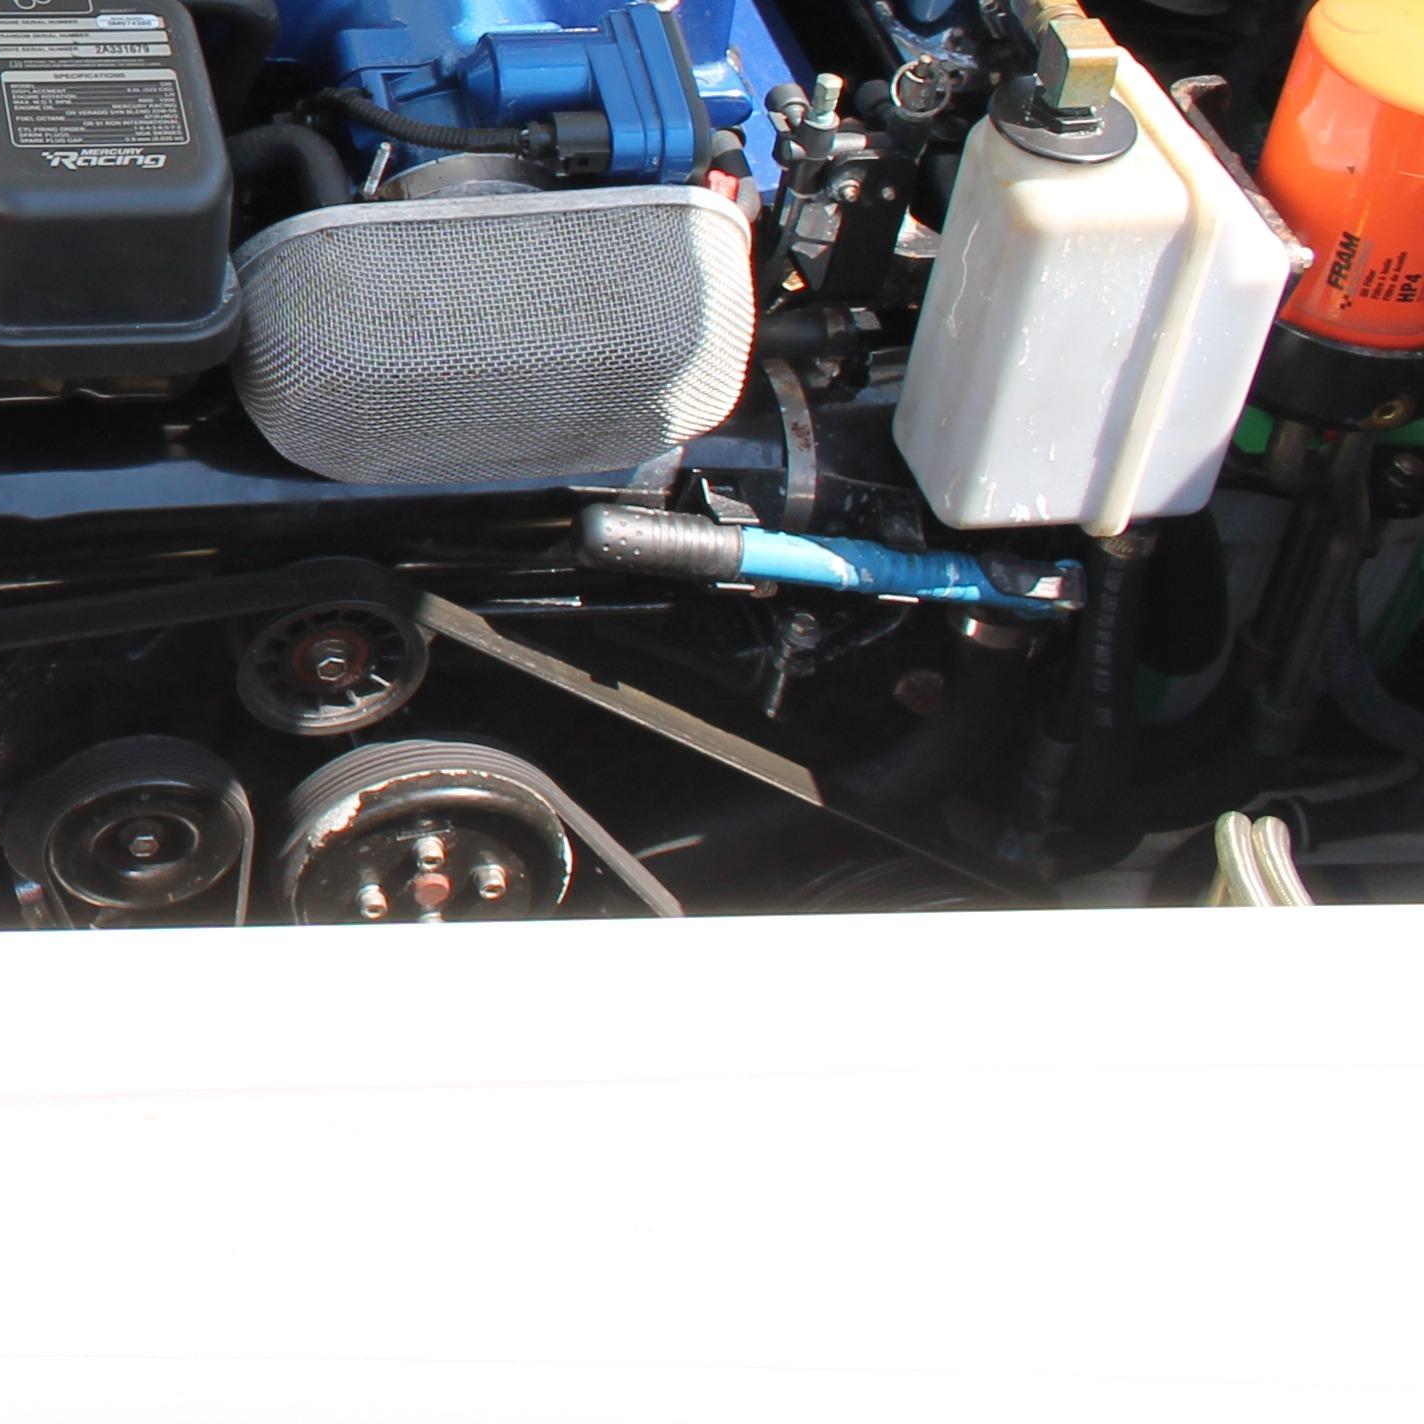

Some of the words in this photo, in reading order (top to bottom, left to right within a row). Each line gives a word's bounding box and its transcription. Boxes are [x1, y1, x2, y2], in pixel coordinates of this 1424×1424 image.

[46, 151, 167, 170] Racing
[80, 147, 144, 156] MERCURY
[1326, 230, 1361, 291] FRAM
[1395, 272, 1423, 303] HP4
